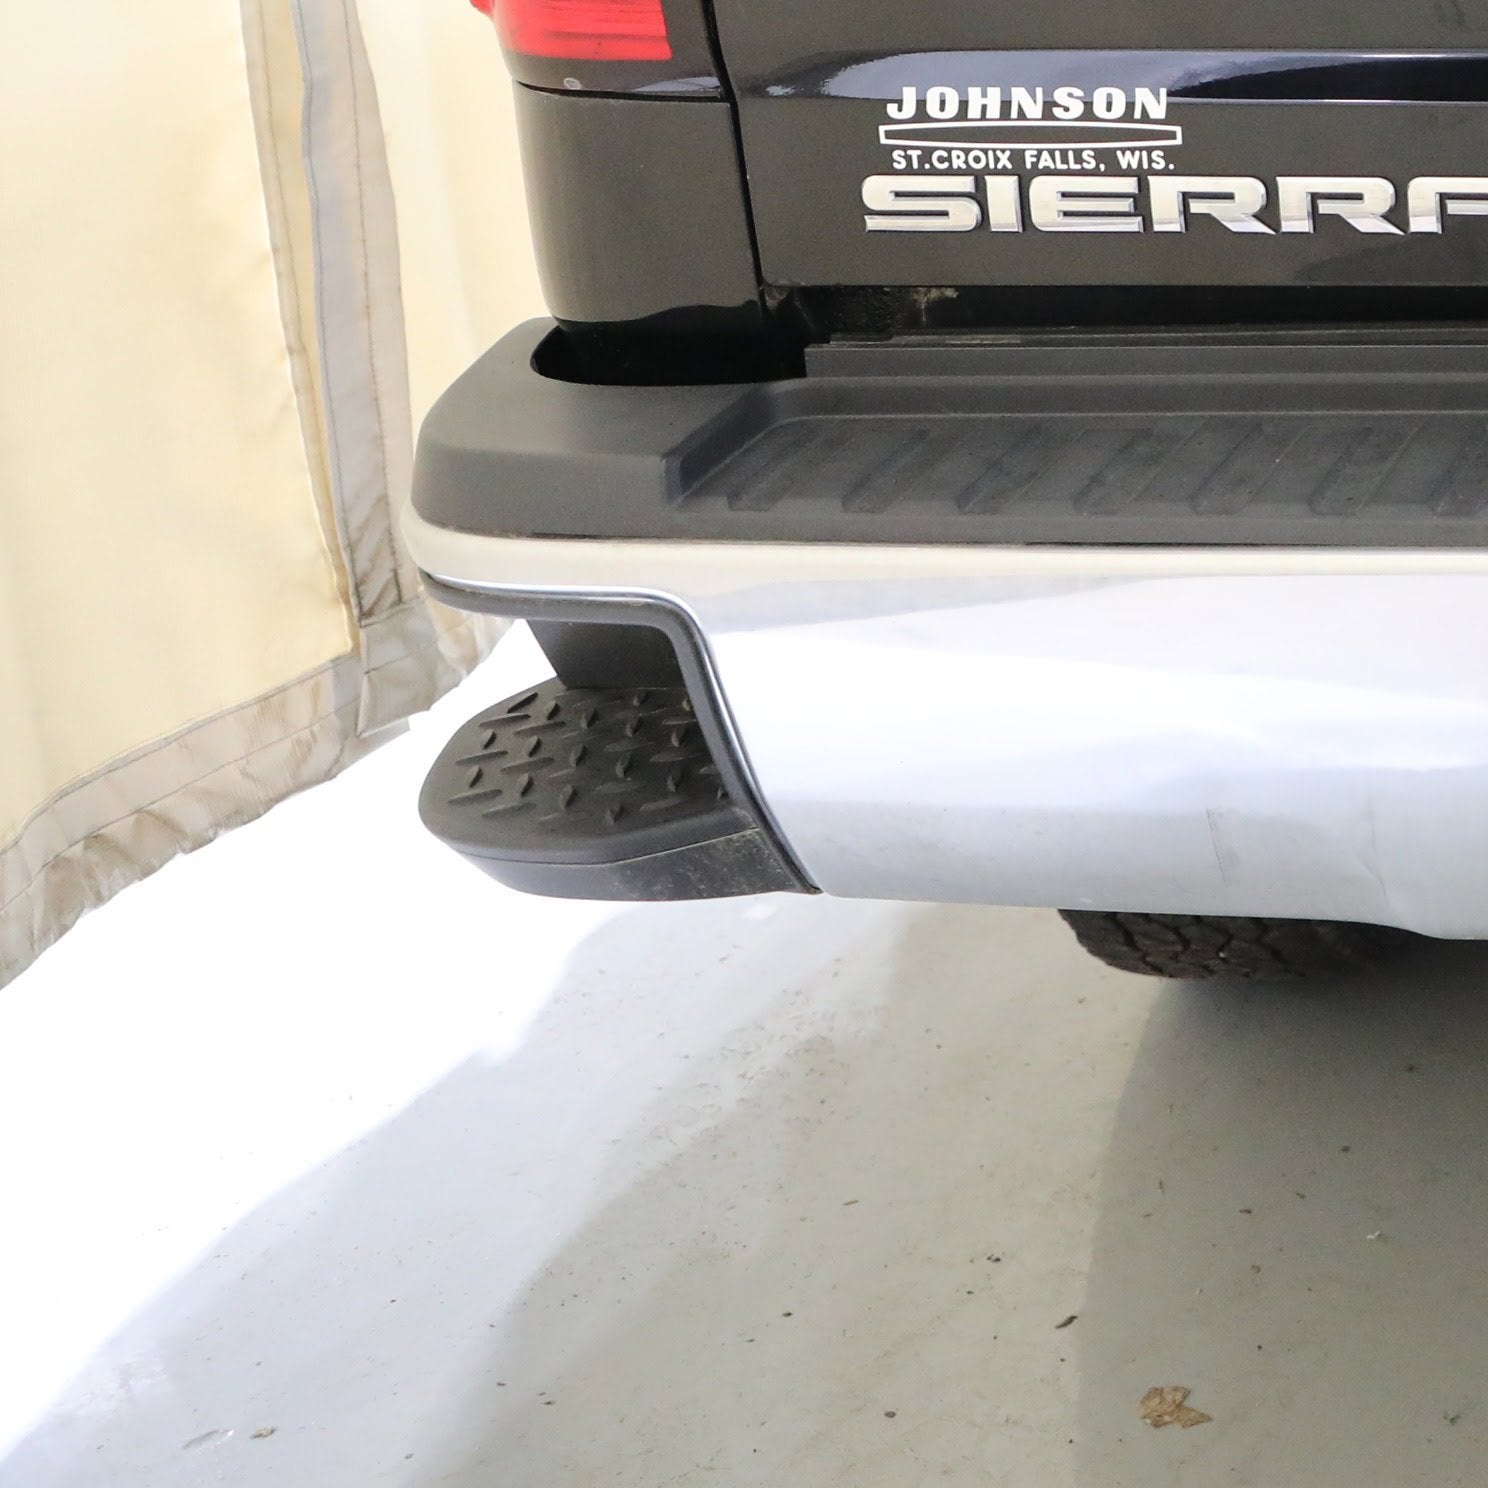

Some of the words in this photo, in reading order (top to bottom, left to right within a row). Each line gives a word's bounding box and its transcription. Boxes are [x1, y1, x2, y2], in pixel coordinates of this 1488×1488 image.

[886, 86, 1168, 120] JOHNSON
[1025, 149, 1106, 173] FALLS,
[1116, 149, 1176, 171] WIS.
